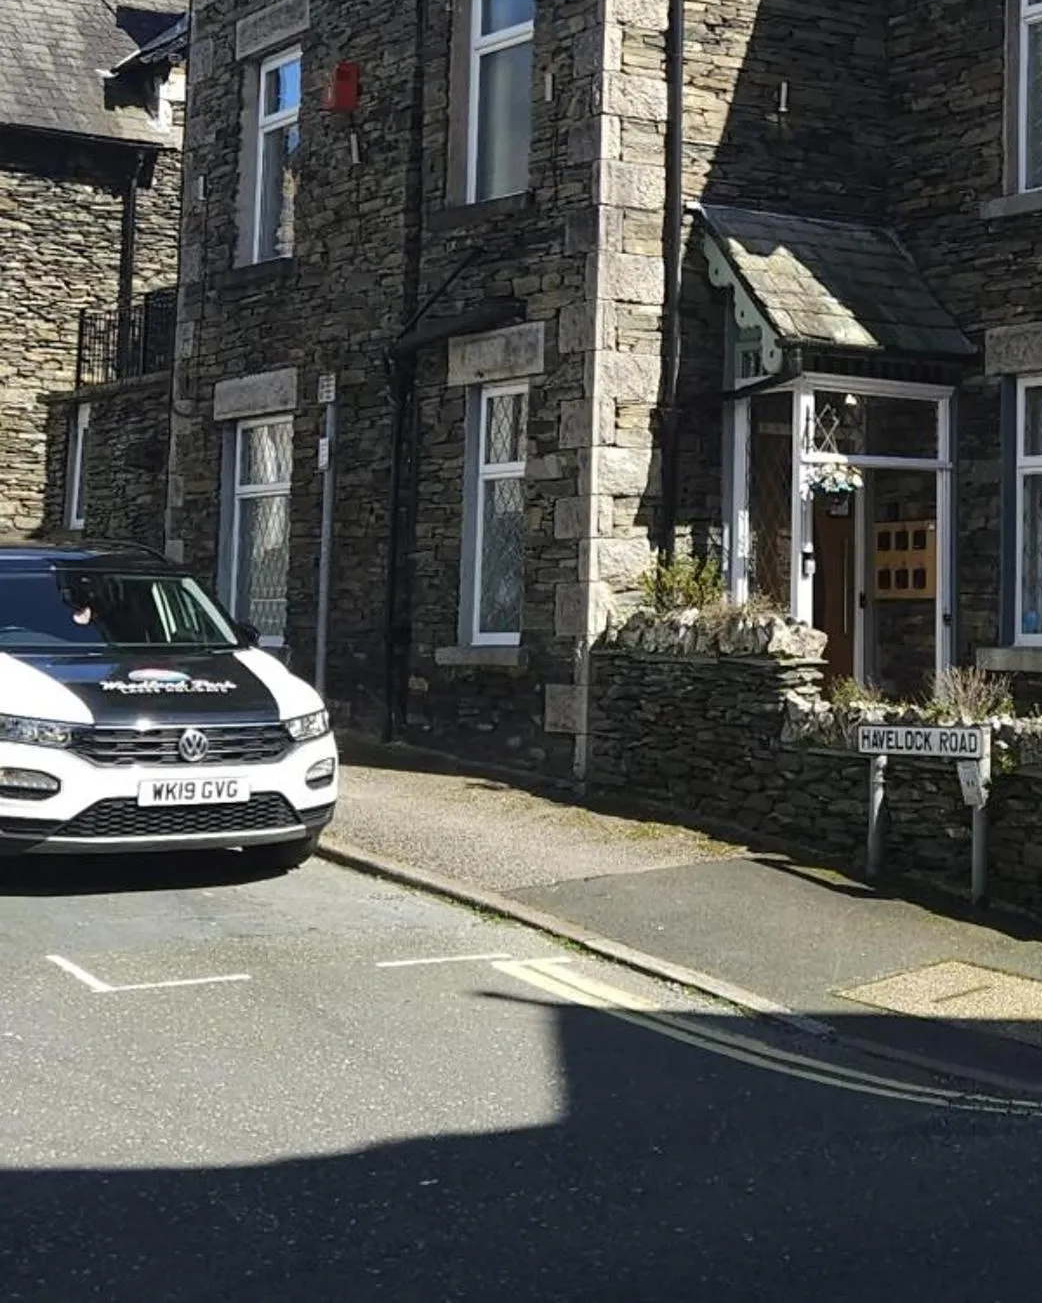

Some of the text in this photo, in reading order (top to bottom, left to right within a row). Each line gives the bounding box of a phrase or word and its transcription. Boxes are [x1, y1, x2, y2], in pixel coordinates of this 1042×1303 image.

[861, 730, 978, 753] HAVELOCK ROAD
[153, 780, 238, 801] WK19 GVG
